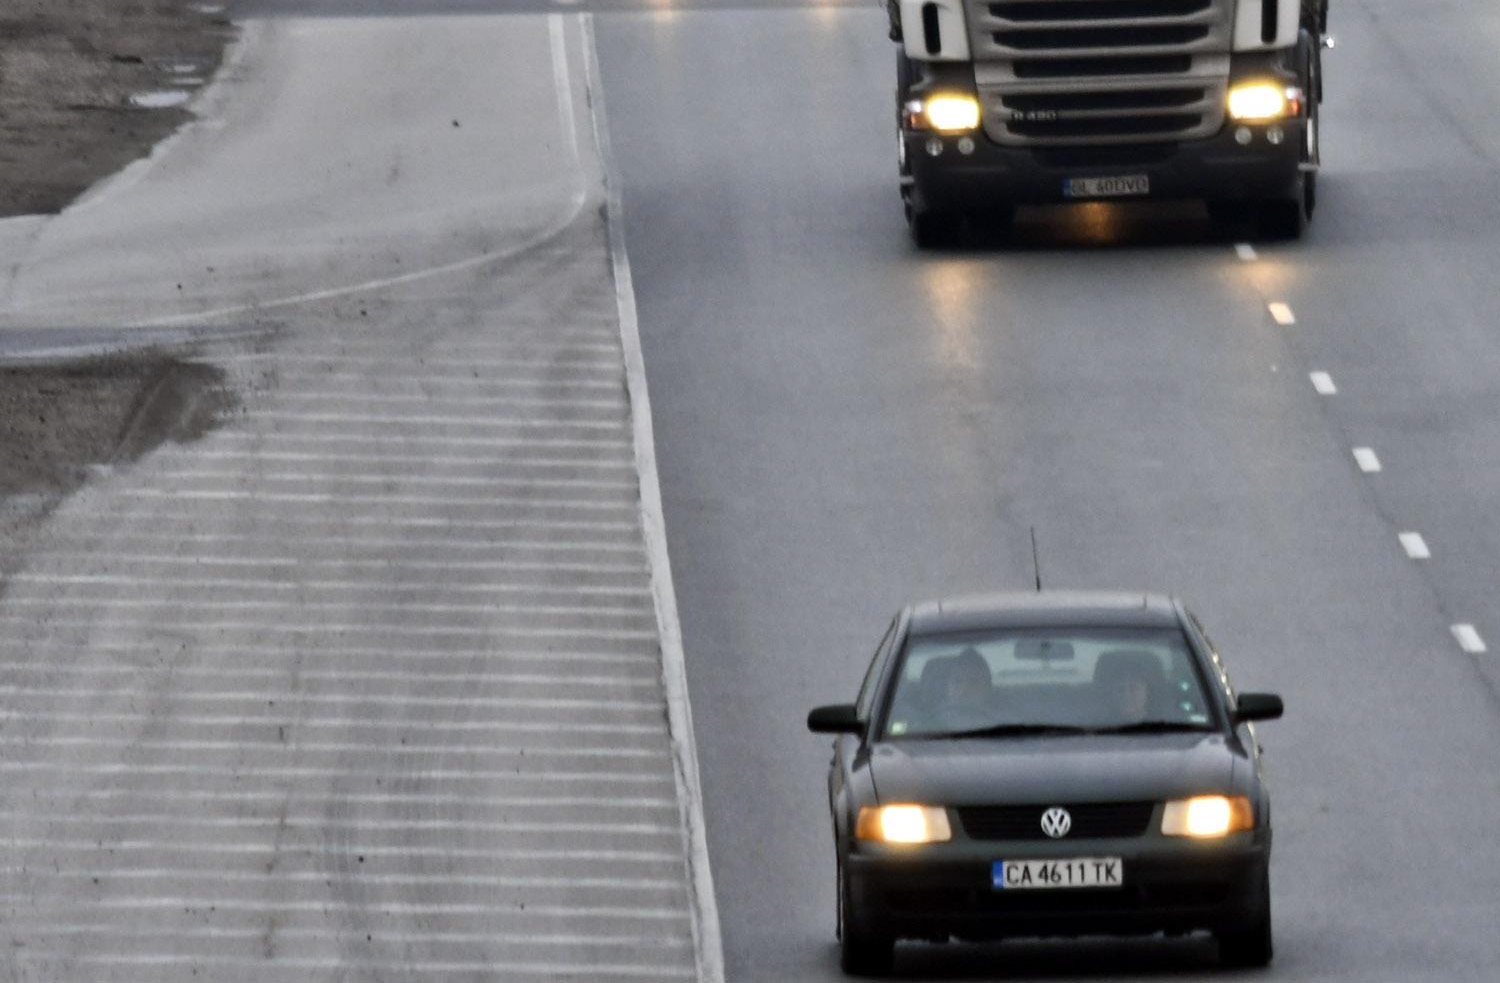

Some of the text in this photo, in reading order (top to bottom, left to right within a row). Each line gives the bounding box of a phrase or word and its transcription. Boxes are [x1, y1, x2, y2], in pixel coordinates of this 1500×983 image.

[1006, 861, 1117, 884] CA 4611 TK
